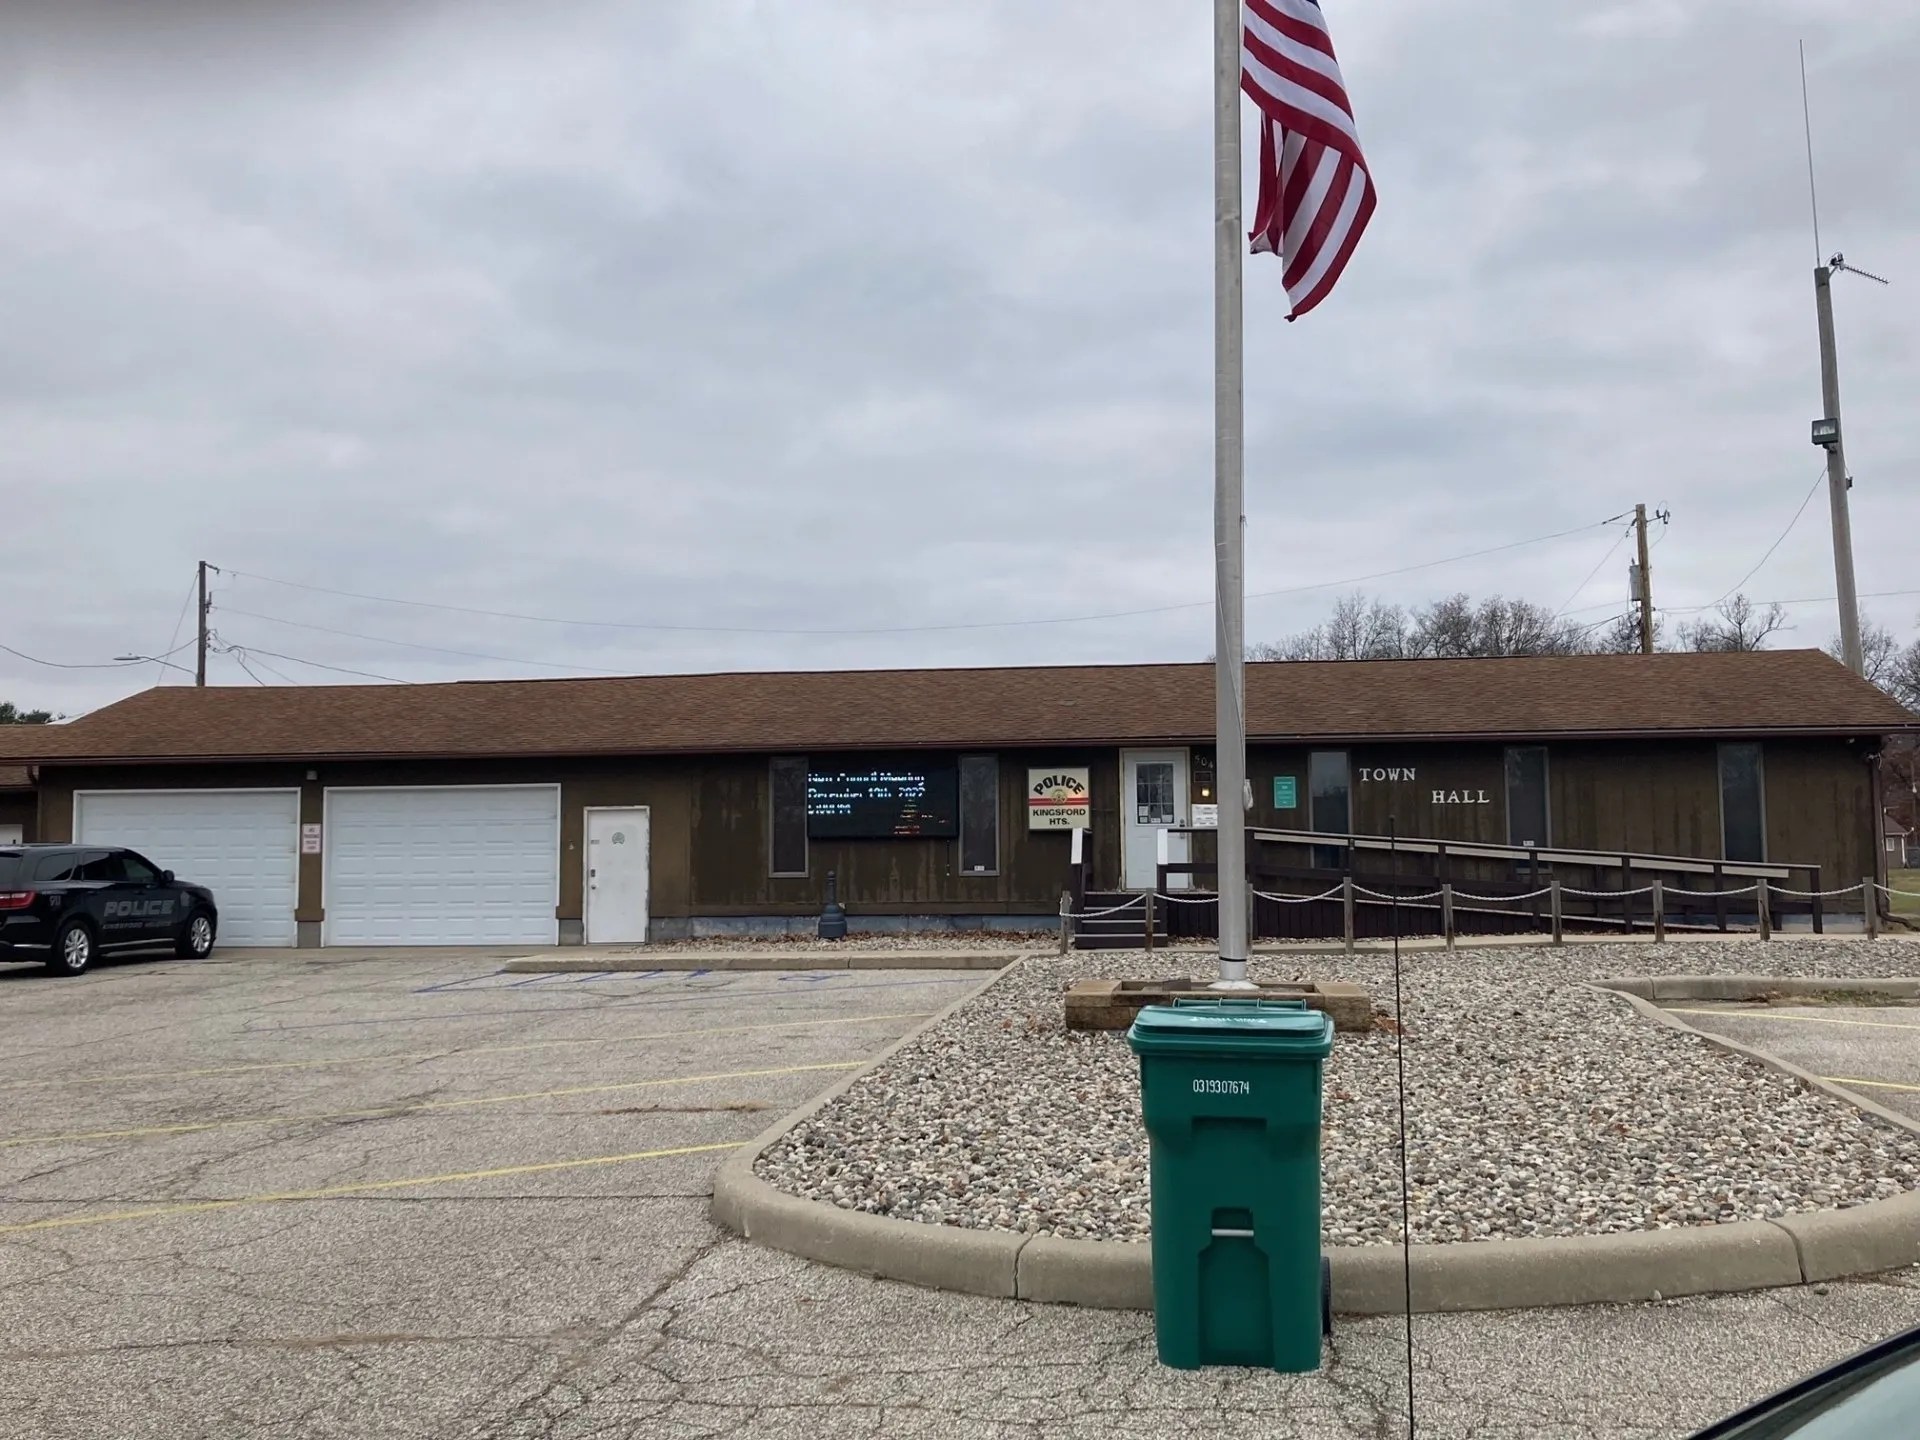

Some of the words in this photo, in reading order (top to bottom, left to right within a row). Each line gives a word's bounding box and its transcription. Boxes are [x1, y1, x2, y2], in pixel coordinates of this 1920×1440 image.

[1359, 767, 1416, 782] TOWN
[1033, 775, 1085, 796] POLICE
[1431, 789, 1490, 804] HALL
[1032, 808, 1087, 817] KINGSFORD
[1049, 817, 1071, 826] HTS.
[103, 900, 175, 917] POLICE
[1193, 1079, 1250, 1094] 0319307674
